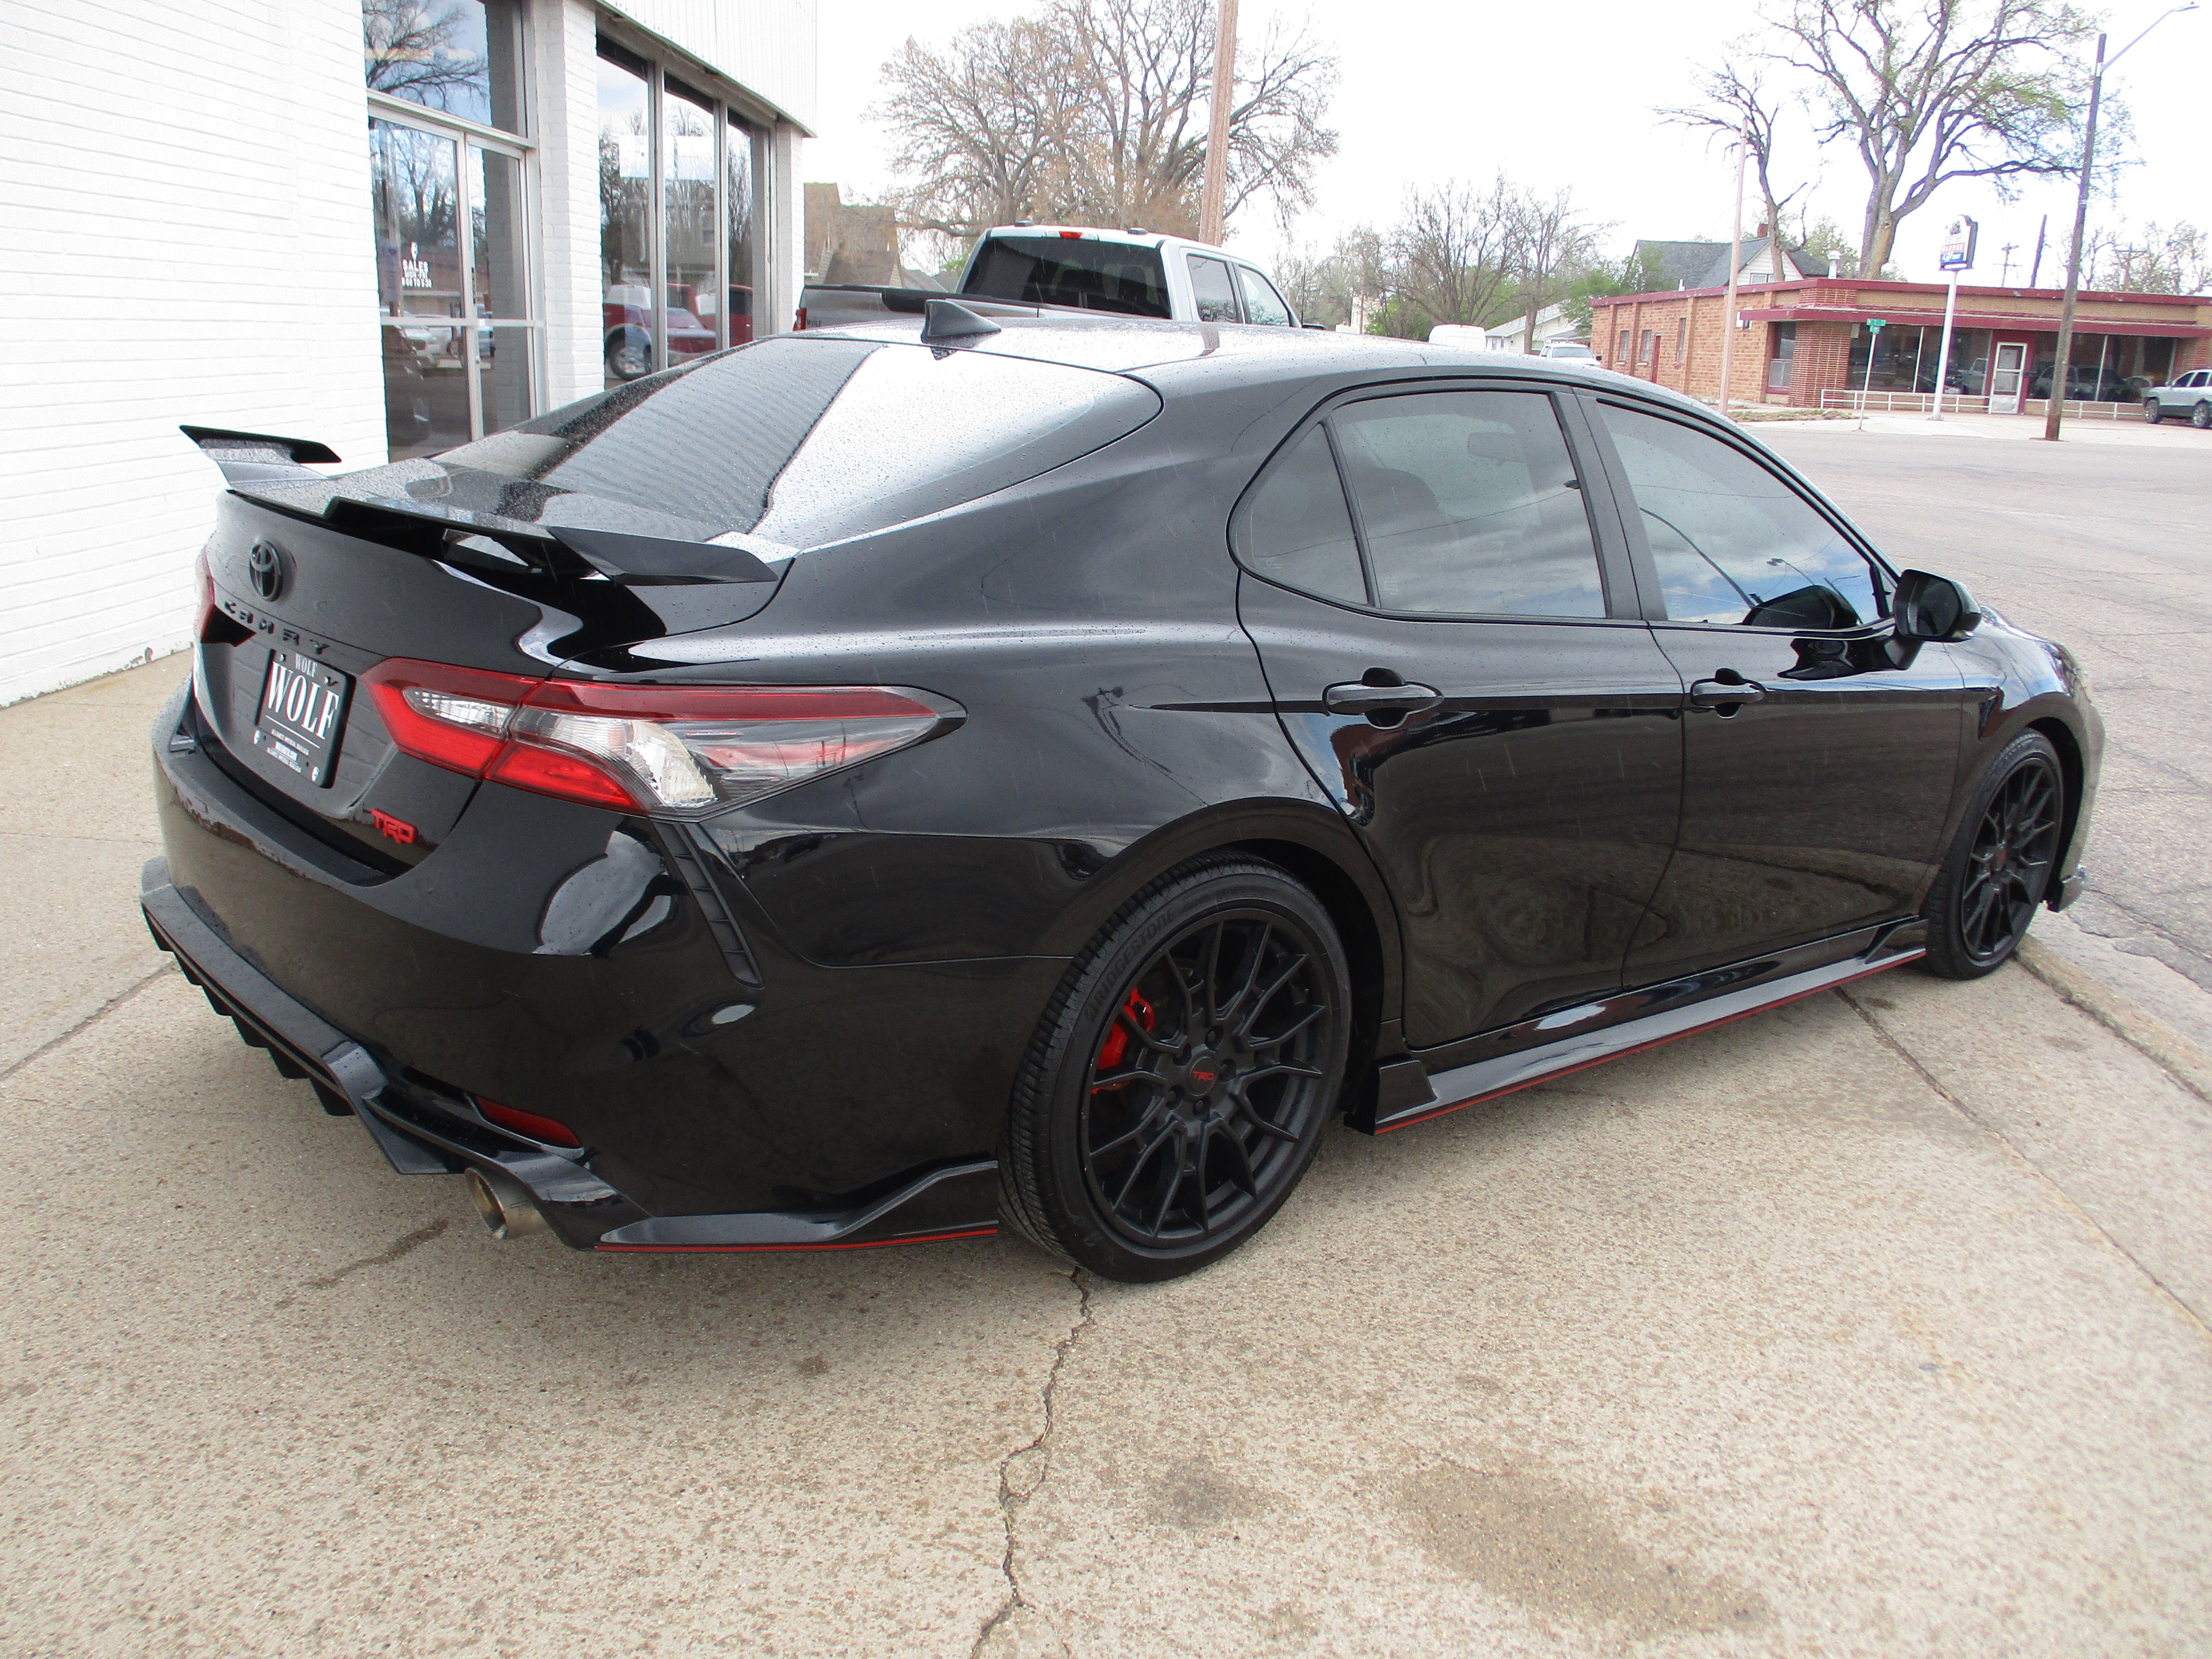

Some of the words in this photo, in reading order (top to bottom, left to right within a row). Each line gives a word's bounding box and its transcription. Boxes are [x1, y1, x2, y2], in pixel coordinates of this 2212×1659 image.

[402, 258, 428, 273] SALES
[413, 278, 421, 287] TO
[295, 653, 318, 678] WOLF
[267, 661, 340, 740] WOLF
[370, 808, 416, 845] TRD
[1083, 908, 1175, 1024] BRIDGESTONE
[1192, 1070, 1215, 1082] TRD
